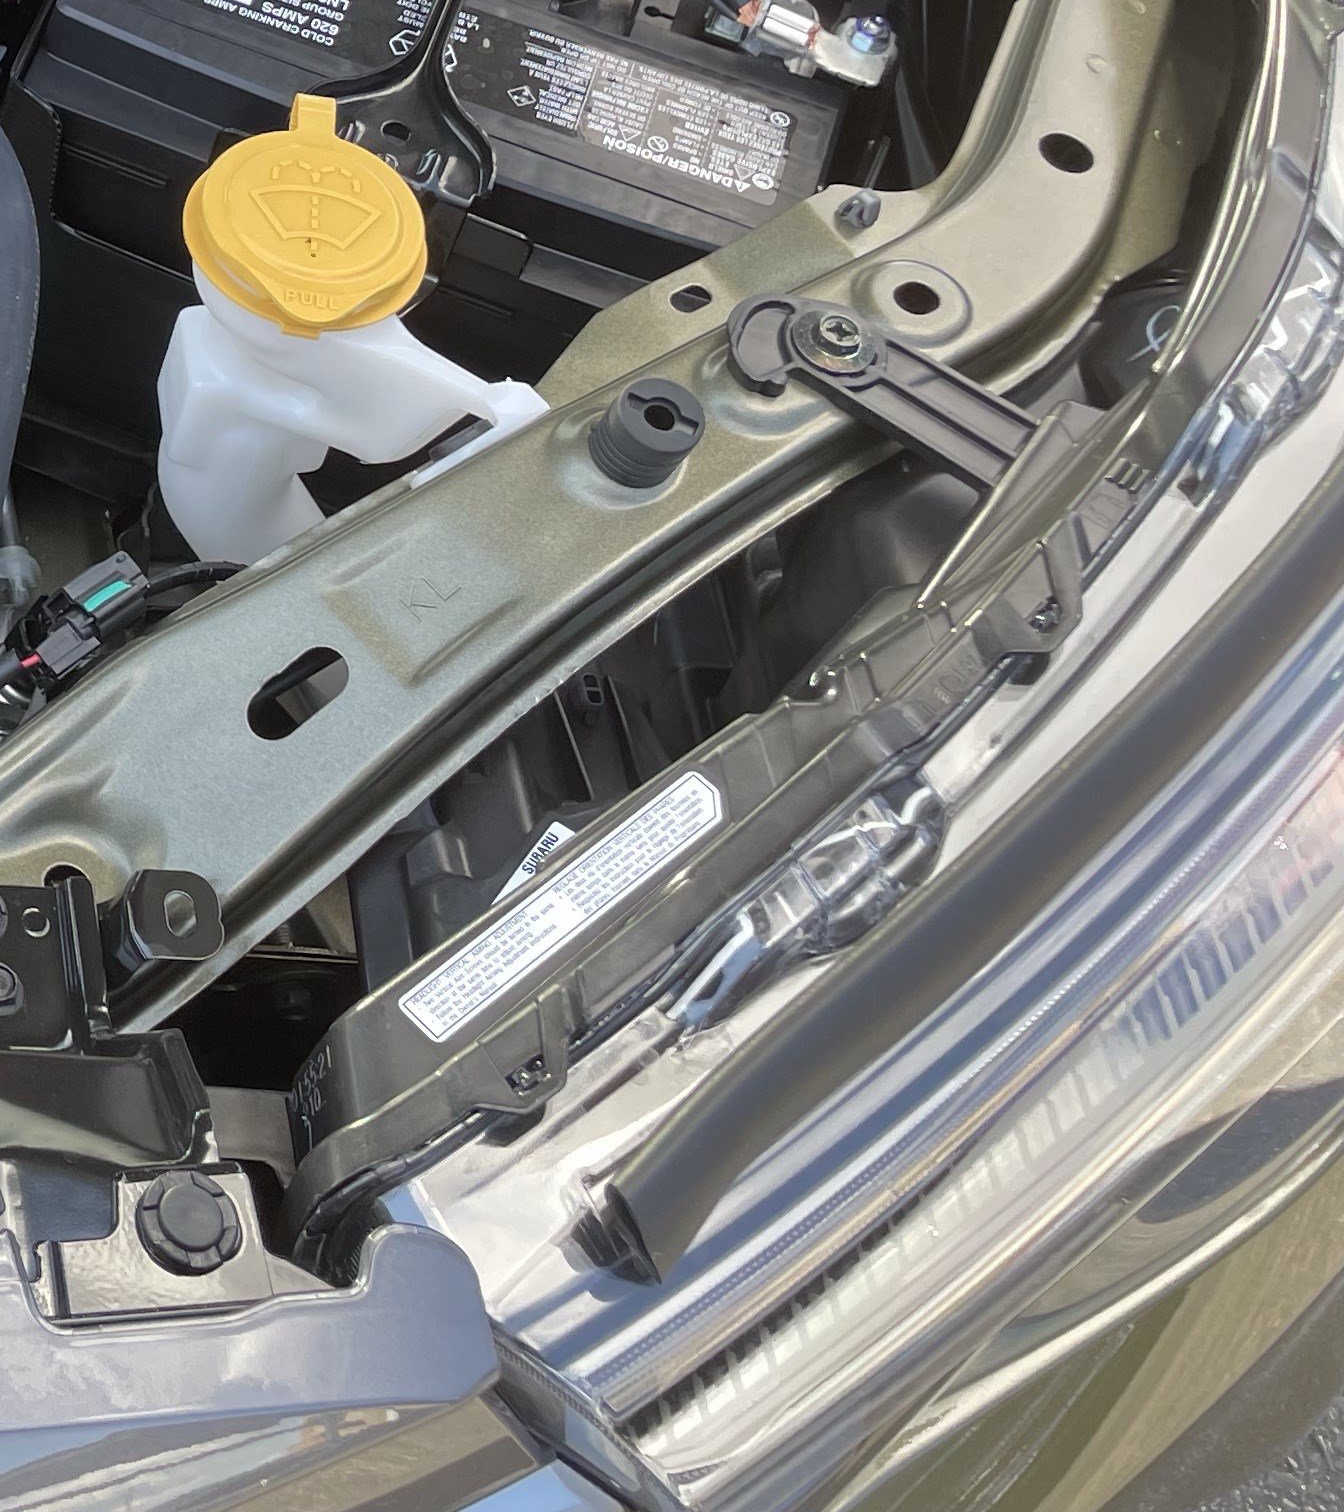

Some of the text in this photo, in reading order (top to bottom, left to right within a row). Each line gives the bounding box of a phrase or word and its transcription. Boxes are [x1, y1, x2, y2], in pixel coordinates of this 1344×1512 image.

[237, 6, 300, 34] CRANKING
[260, 0, 339, 36] 620 AMPS
[301, 0, 344, 22] GROUP
[299, 27, 334, 47] COLD
[284, 288, 340, 311] PULL
